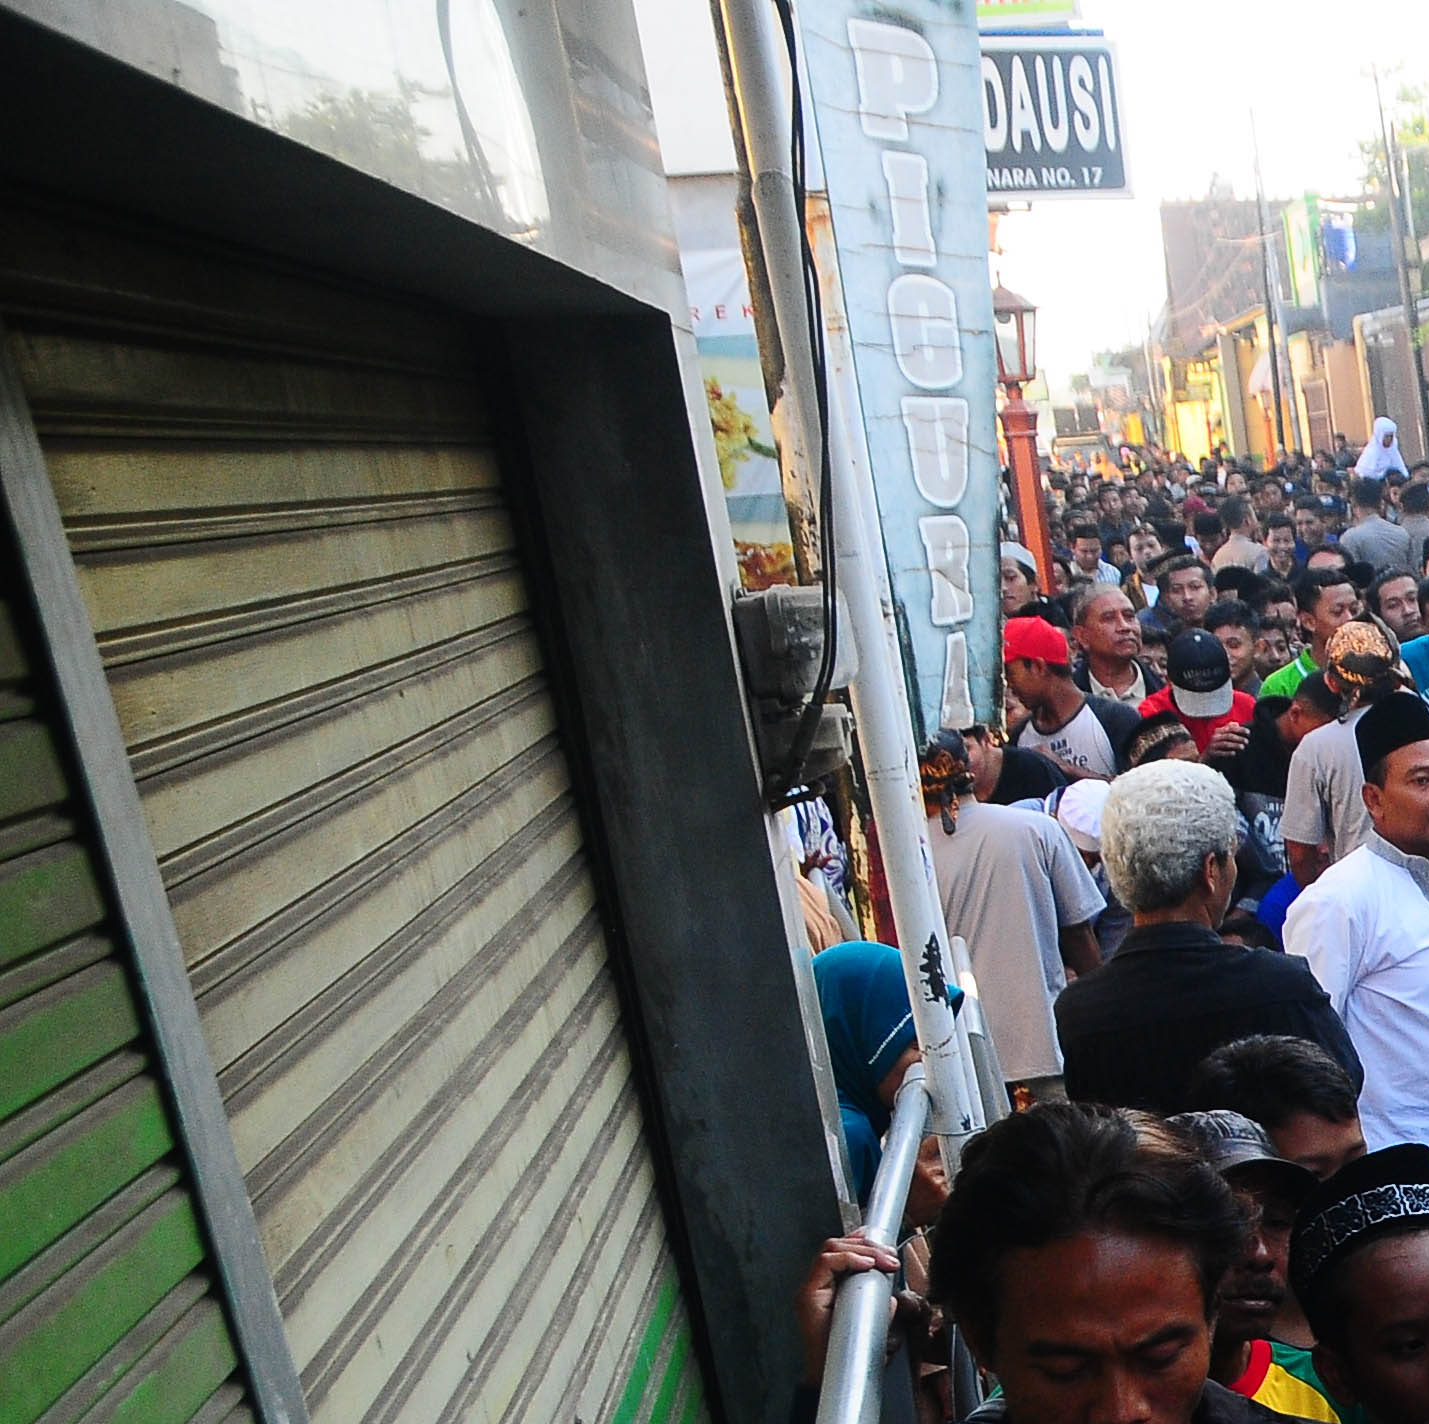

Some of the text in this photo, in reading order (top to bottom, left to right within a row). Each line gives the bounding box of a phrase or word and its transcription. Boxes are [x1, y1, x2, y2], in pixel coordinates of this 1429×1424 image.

[981, 54, 1116, 154] DAUSI
[1041, 166, 1076, 189] NO.
[1080, 166, 1104, 187] 17
